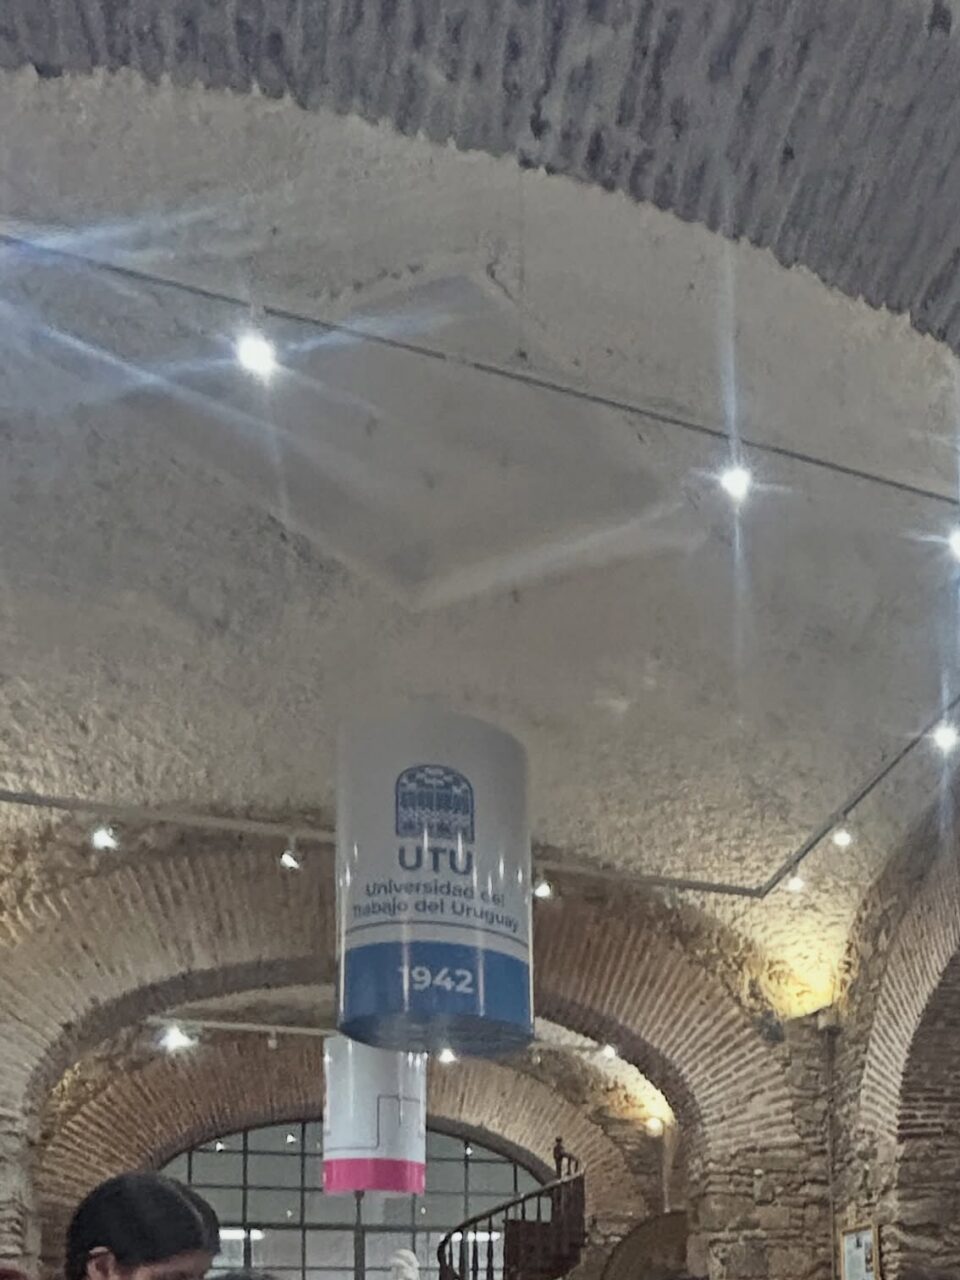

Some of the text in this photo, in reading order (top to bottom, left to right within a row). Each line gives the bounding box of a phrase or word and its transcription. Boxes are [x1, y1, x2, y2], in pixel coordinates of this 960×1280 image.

[398, 845, 473, 875] UTU
[365, 879, 474, 900] Universidad
[414, 899, 444, 914] del
[451, 900, 519, 933] Uruguay
[398, 965, 474, 994] 1942
